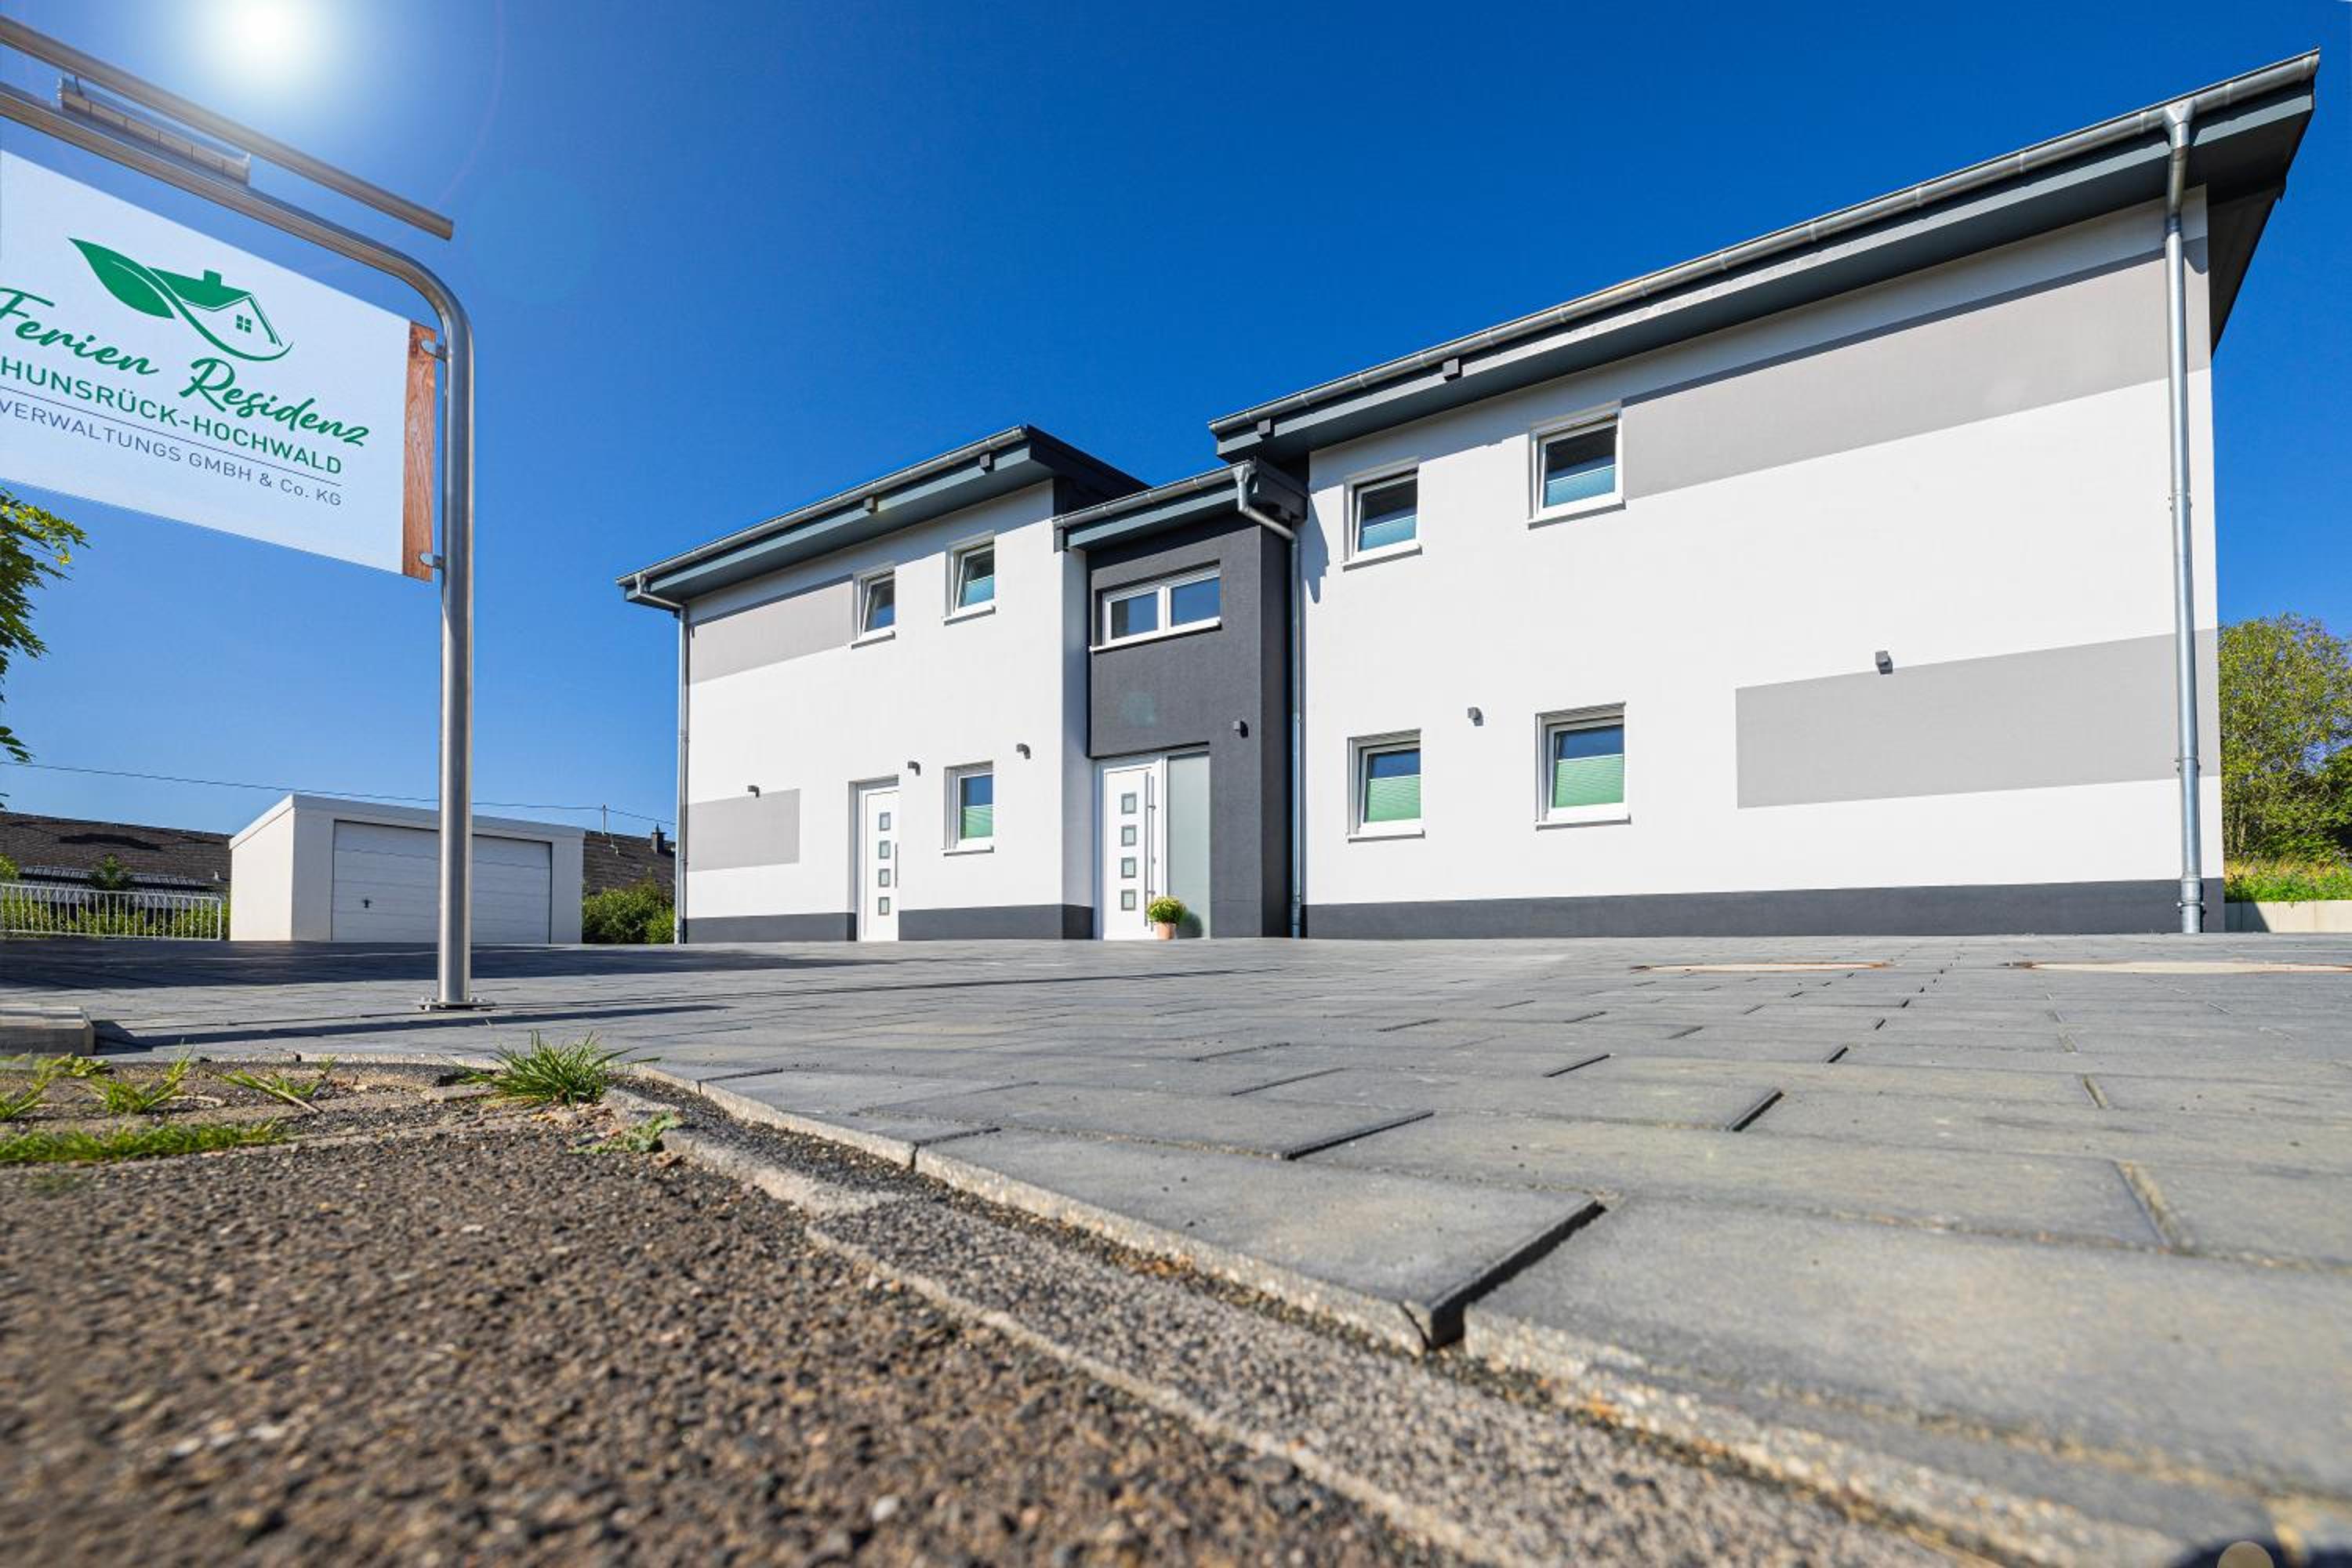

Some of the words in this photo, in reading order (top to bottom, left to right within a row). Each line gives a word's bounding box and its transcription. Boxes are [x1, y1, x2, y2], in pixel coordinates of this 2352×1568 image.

[0, 287, 160, 376] Ferien
[178, 357, 369, 448] Residenz
[1, 356, 343, 474] HUNSRÜCK-HOCHWALD
[0, 400, 182, 463] VERWALTUNGS
[189, 452, 252, 482] GMBH
[260, 472, 273, 488] &
[316, 488, 342, 506] KG
